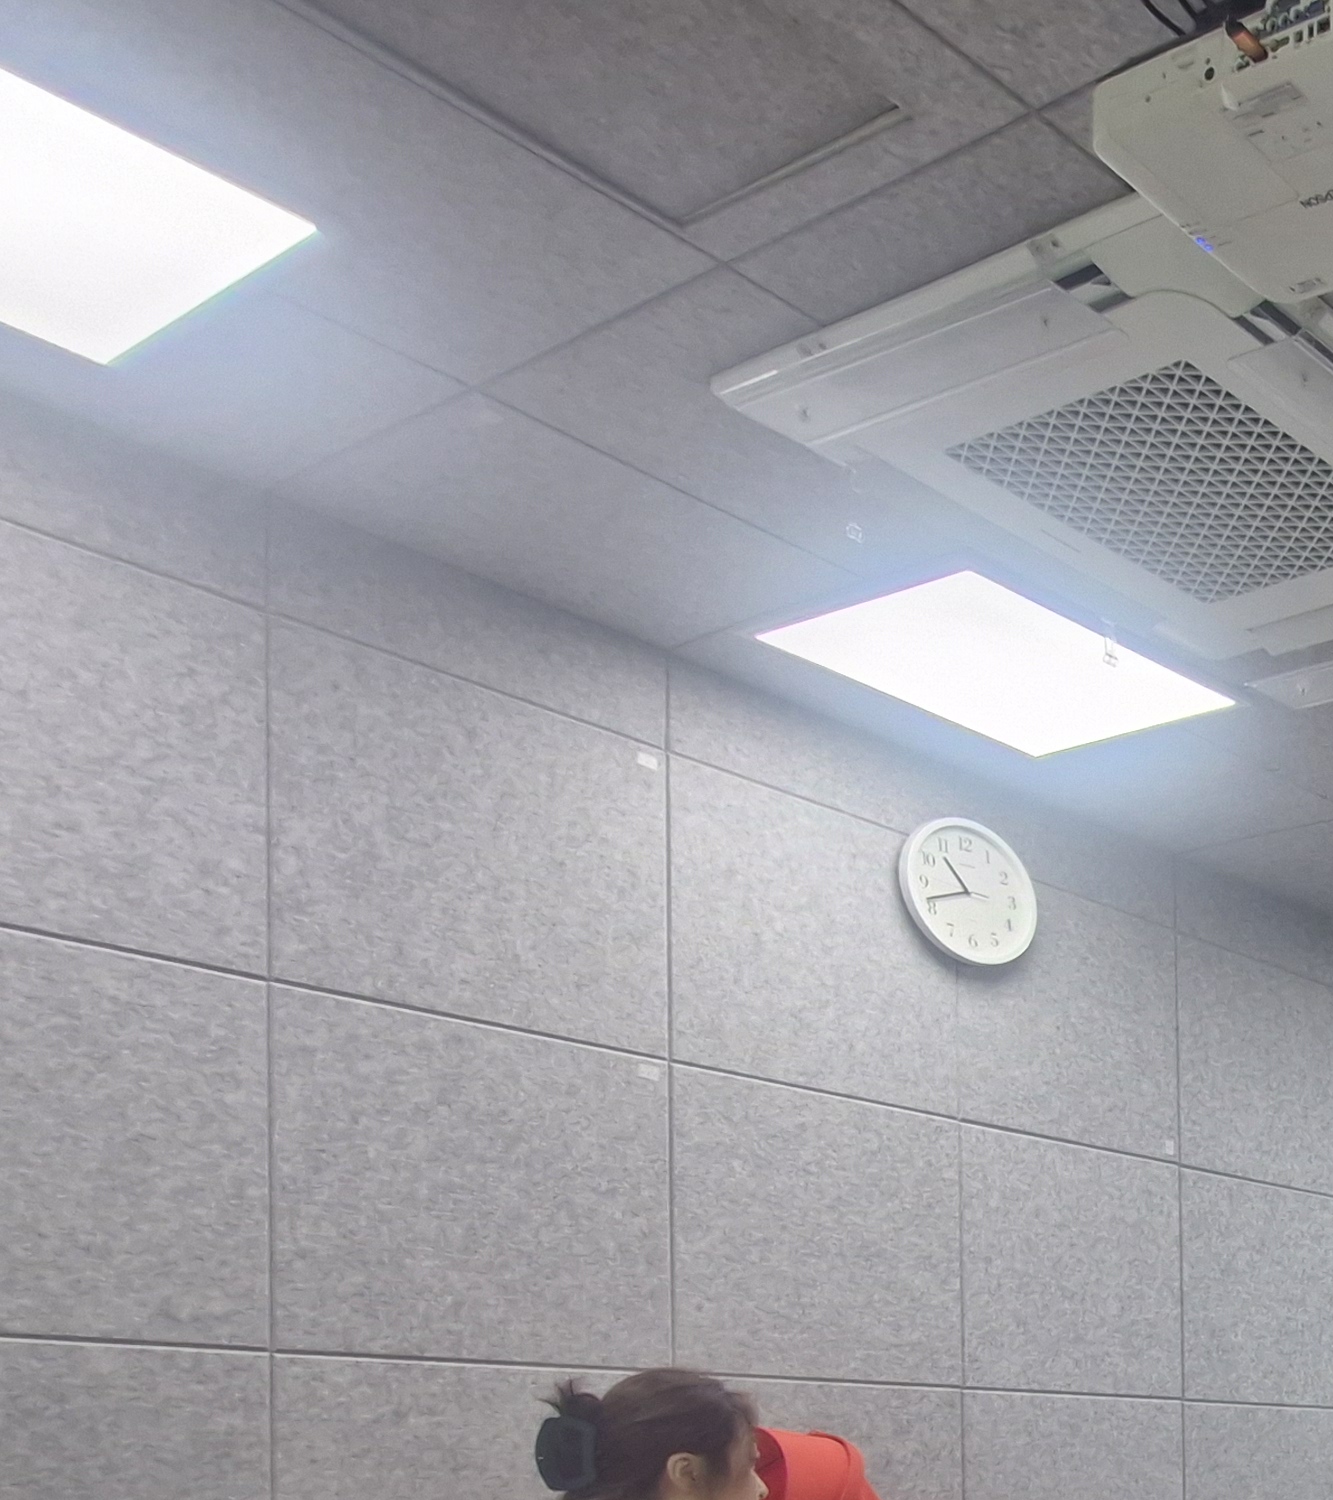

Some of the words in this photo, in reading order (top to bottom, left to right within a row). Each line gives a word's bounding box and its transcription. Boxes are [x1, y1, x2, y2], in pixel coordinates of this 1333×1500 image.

[937, 837, 949, 854] 11
[958, 835, 973, 853] 12
[921, 850, 936, 867] 10
[985, 850, 991, 865] 1
[919, 874, 929, 888] 9
[999, 871, 1008, 886] 2
[927, 899, 937, 916] 8
[1008, 896, 1017, 911] 3
[946, 922, 954, 937] 7
[968, 934, 978, 948] 6
[990, 932, 999, 947] 5
